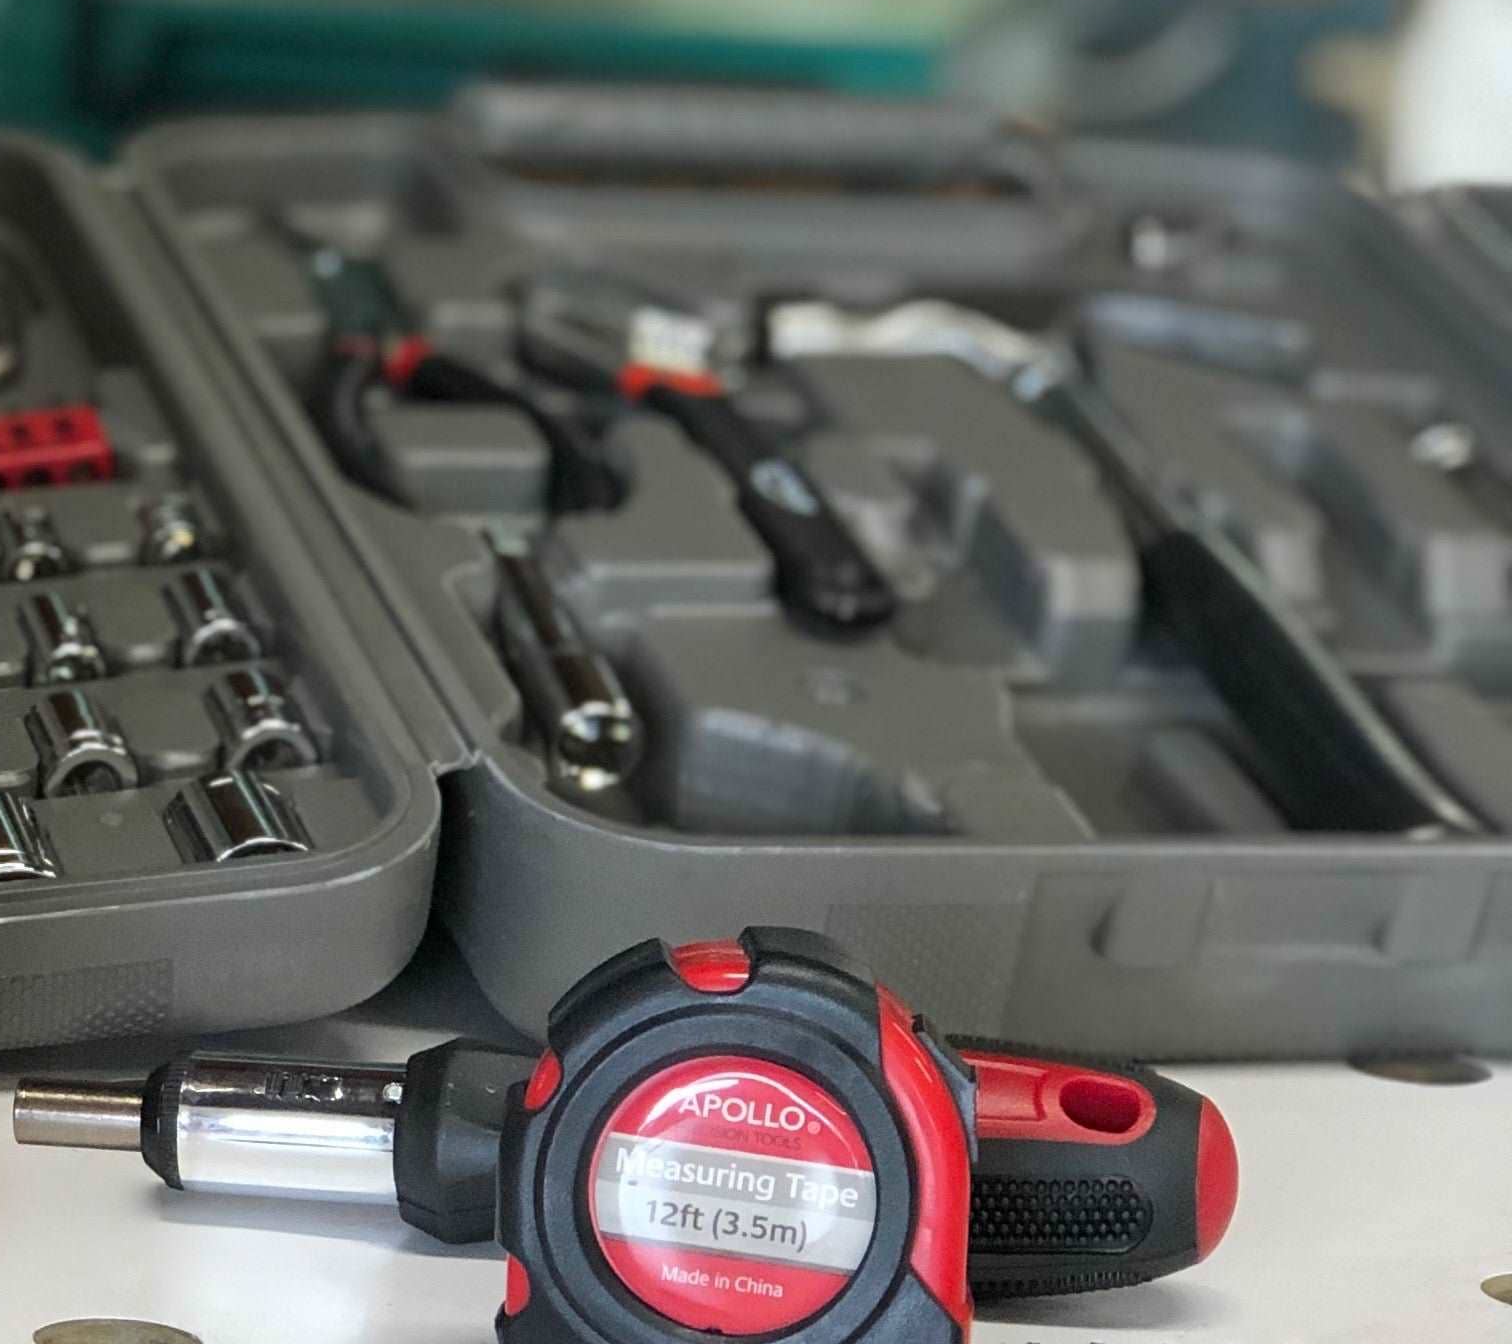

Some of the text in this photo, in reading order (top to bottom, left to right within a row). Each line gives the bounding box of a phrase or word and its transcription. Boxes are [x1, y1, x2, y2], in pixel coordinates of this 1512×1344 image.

[679, 1093, 806, 1132] APOLLO
[615, 1146, 859, 1209] Measuring Tape
[646, 1199, 808, 1254] 12ft (3.5m)
[660, 1263, 784, 1299] Made in China
